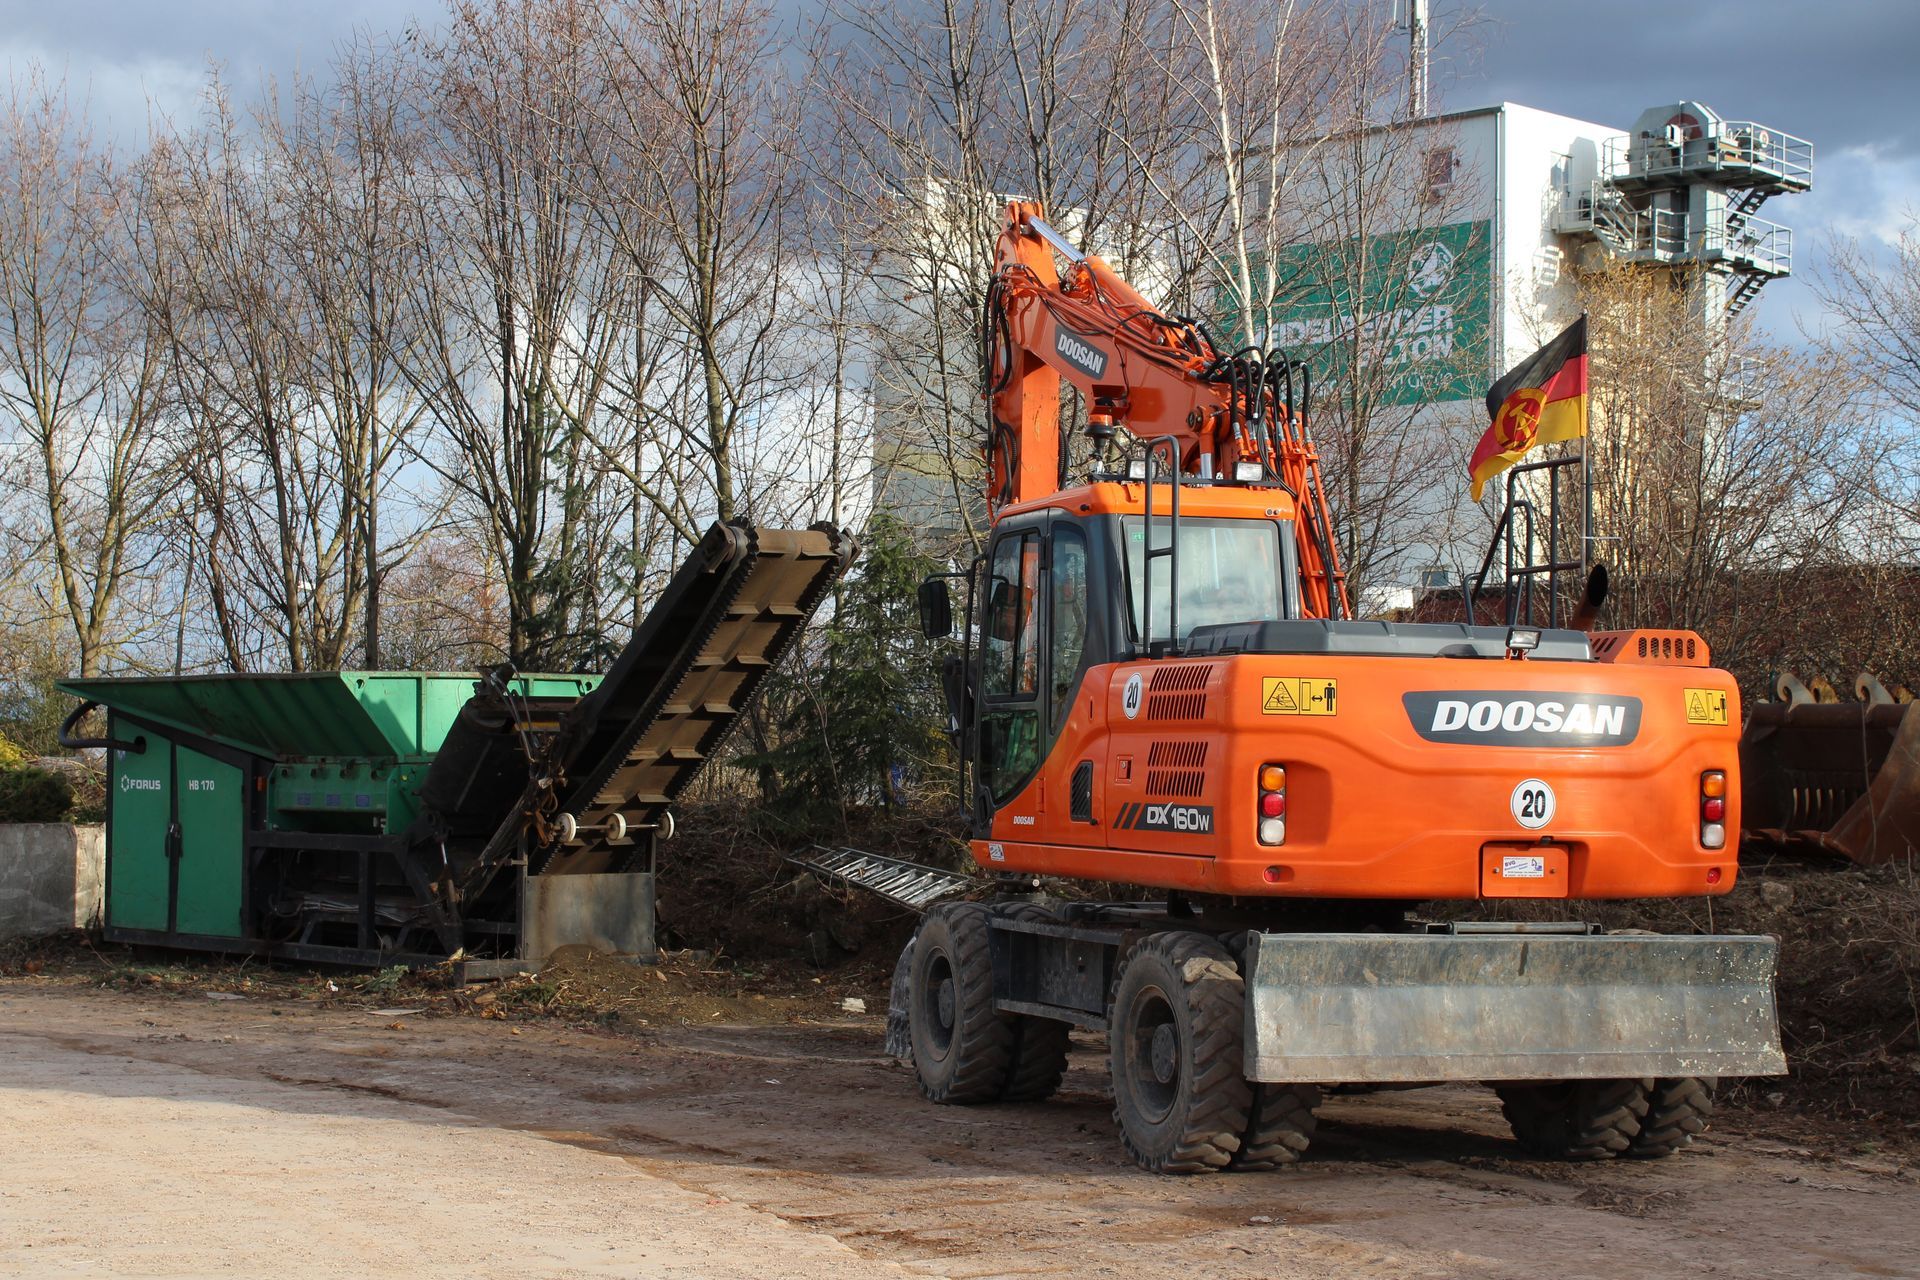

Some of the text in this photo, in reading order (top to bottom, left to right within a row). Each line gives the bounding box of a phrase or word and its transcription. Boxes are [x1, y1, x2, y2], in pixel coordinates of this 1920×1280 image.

[1057, 333, 1103, 374] DOOSAN
[1126, 681, 1139, 709] 20
[1431, 700, 1626, 736] DOOSAN
[130, 779, 161, 790] FORUS
[188, 780, 215, 791] HB 170
[1521, 789, 1546, 819] 20
[1013, 815, 1035, 825] DOOSAN
